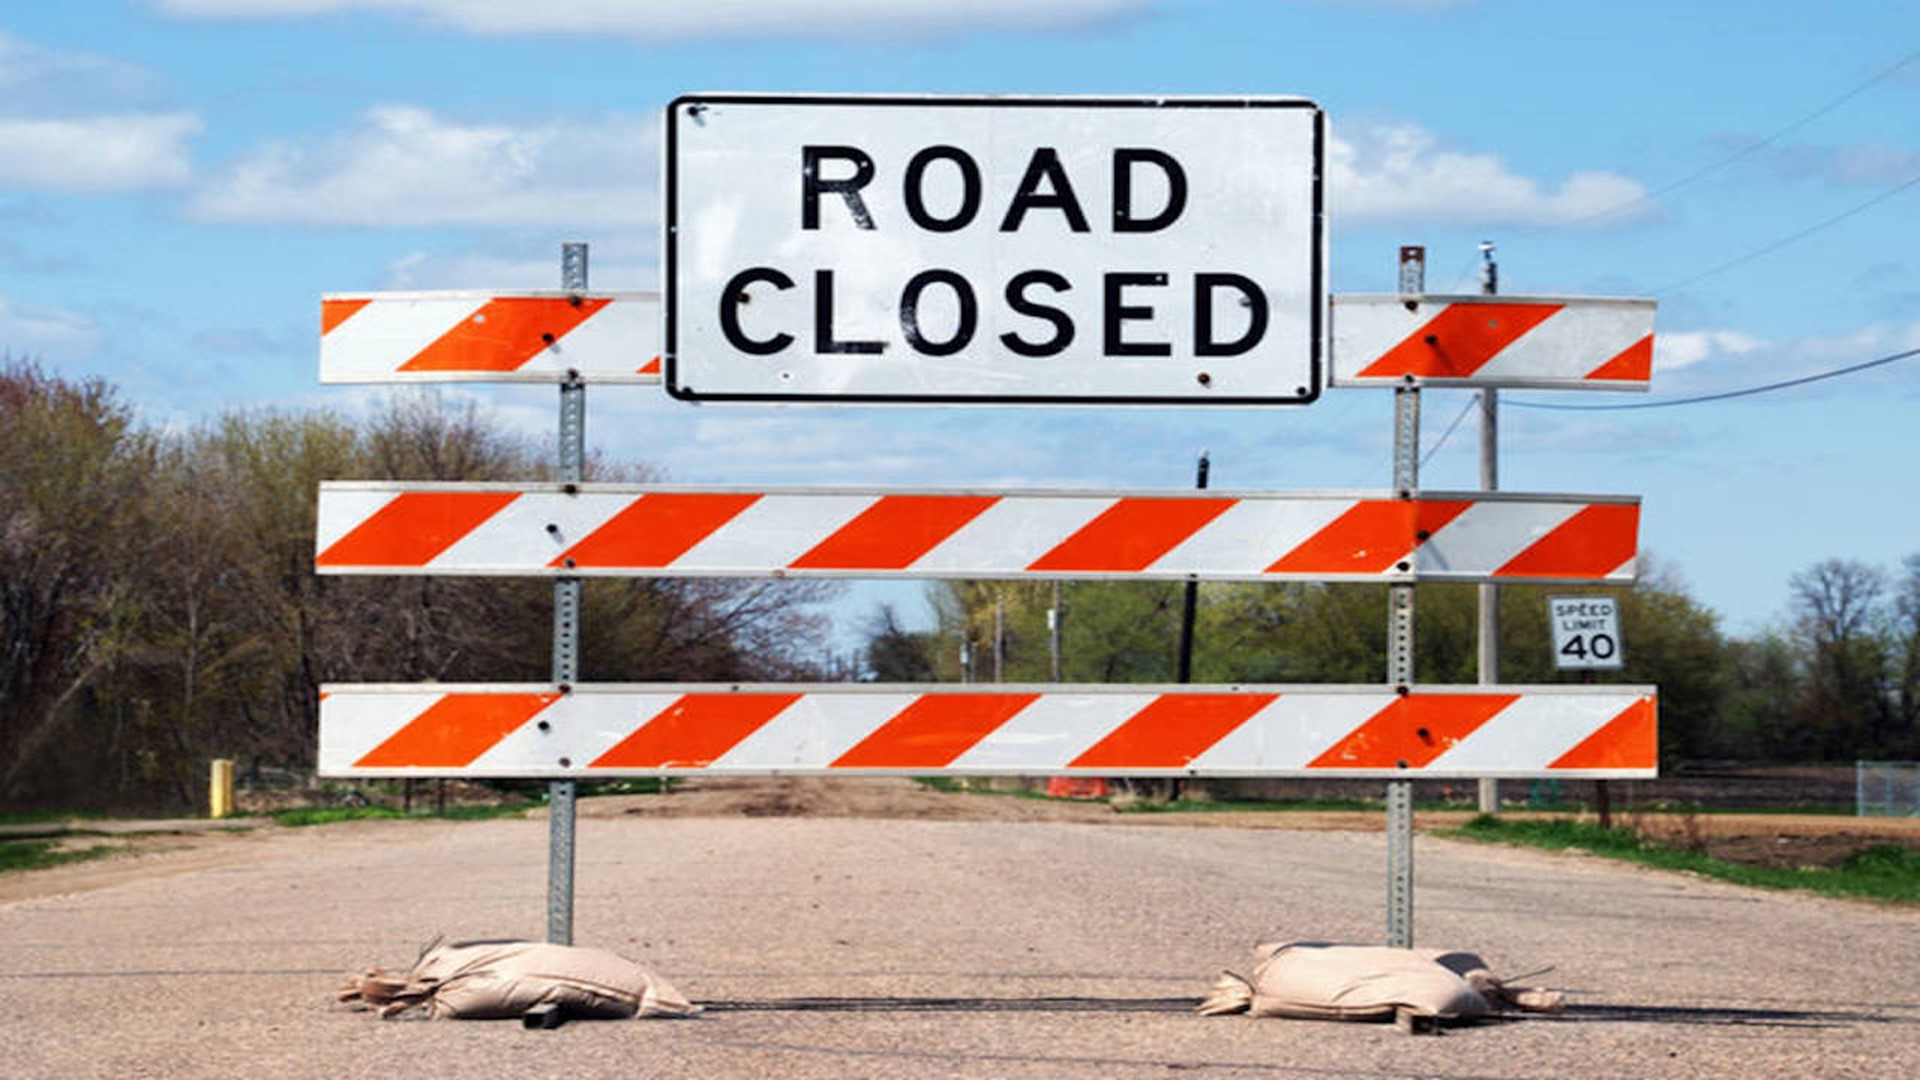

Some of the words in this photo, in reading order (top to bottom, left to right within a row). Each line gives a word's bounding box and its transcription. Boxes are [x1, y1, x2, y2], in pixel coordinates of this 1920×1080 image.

[801, 145, 1189, 233] ROAD
[719, 267, 1269, 358] CLOSED
[1555, 603, 1613, 617] SPEED
[1563, 619, 1605, 631] LIMIT
[1560, 633, 1615, 660] 40
